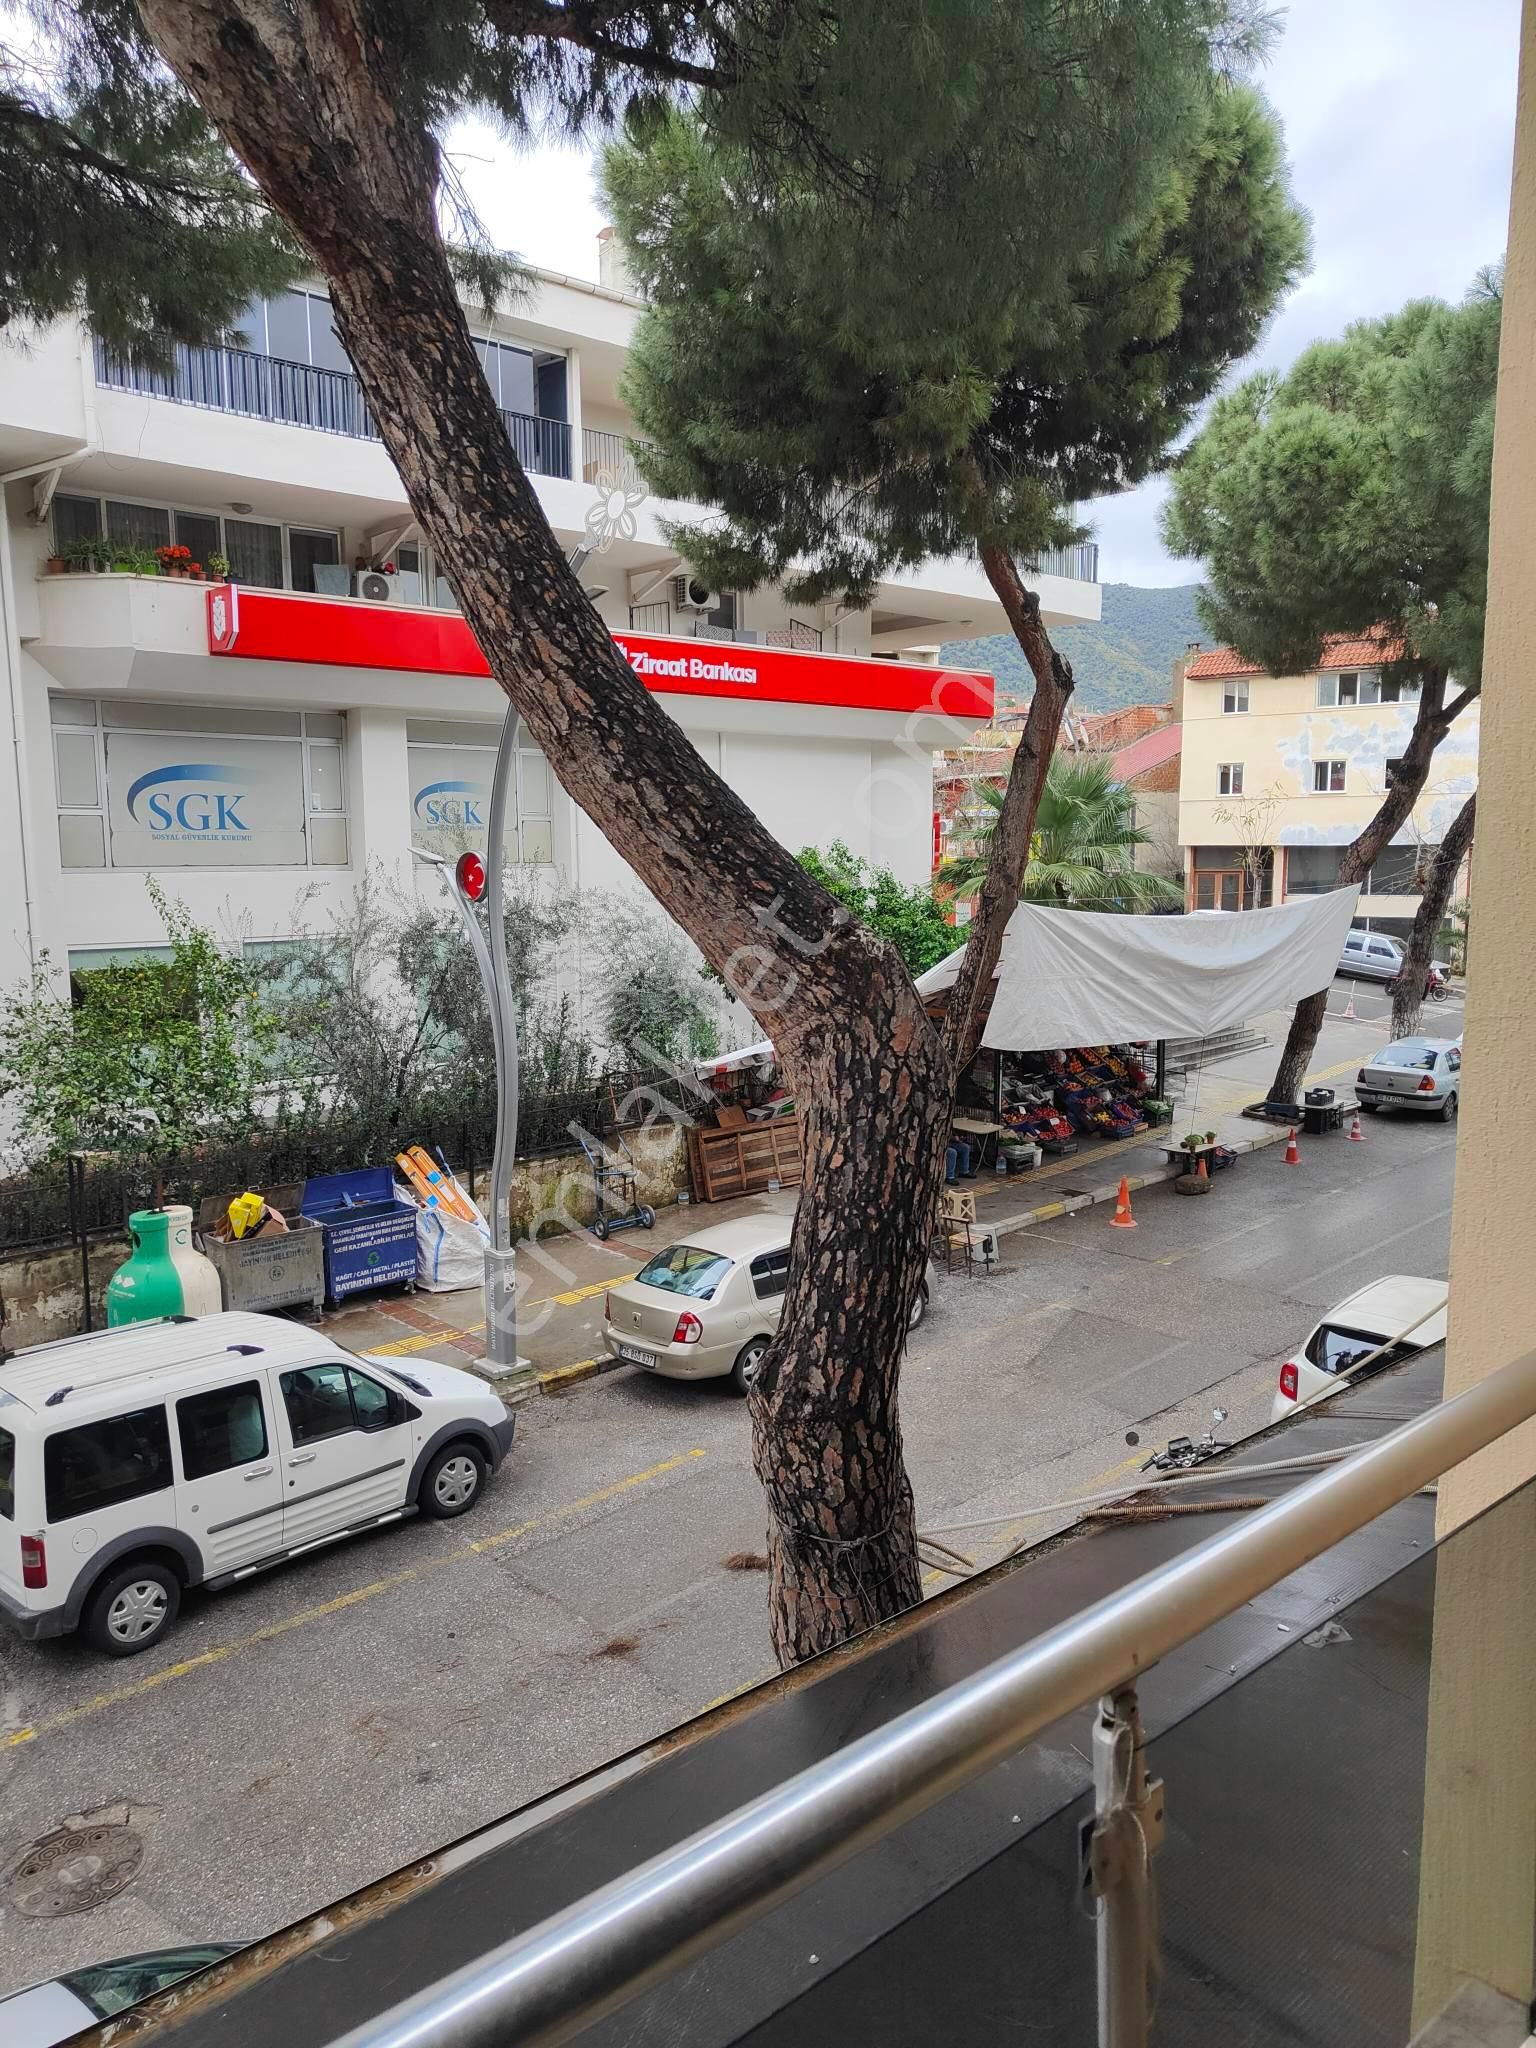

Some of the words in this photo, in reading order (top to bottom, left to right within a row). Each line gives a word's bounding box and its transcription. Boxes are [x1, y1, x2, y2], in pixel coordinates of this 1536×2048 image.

[629, 652, 688, 678] Ziraat
[689, 659, 757, 684] Bankası
[148, 793, 251, 831] SGK
[335, 1277, 373, 1292] BAYINDIR
[373, 1266, 416, 1284] BELEDİYESİ
